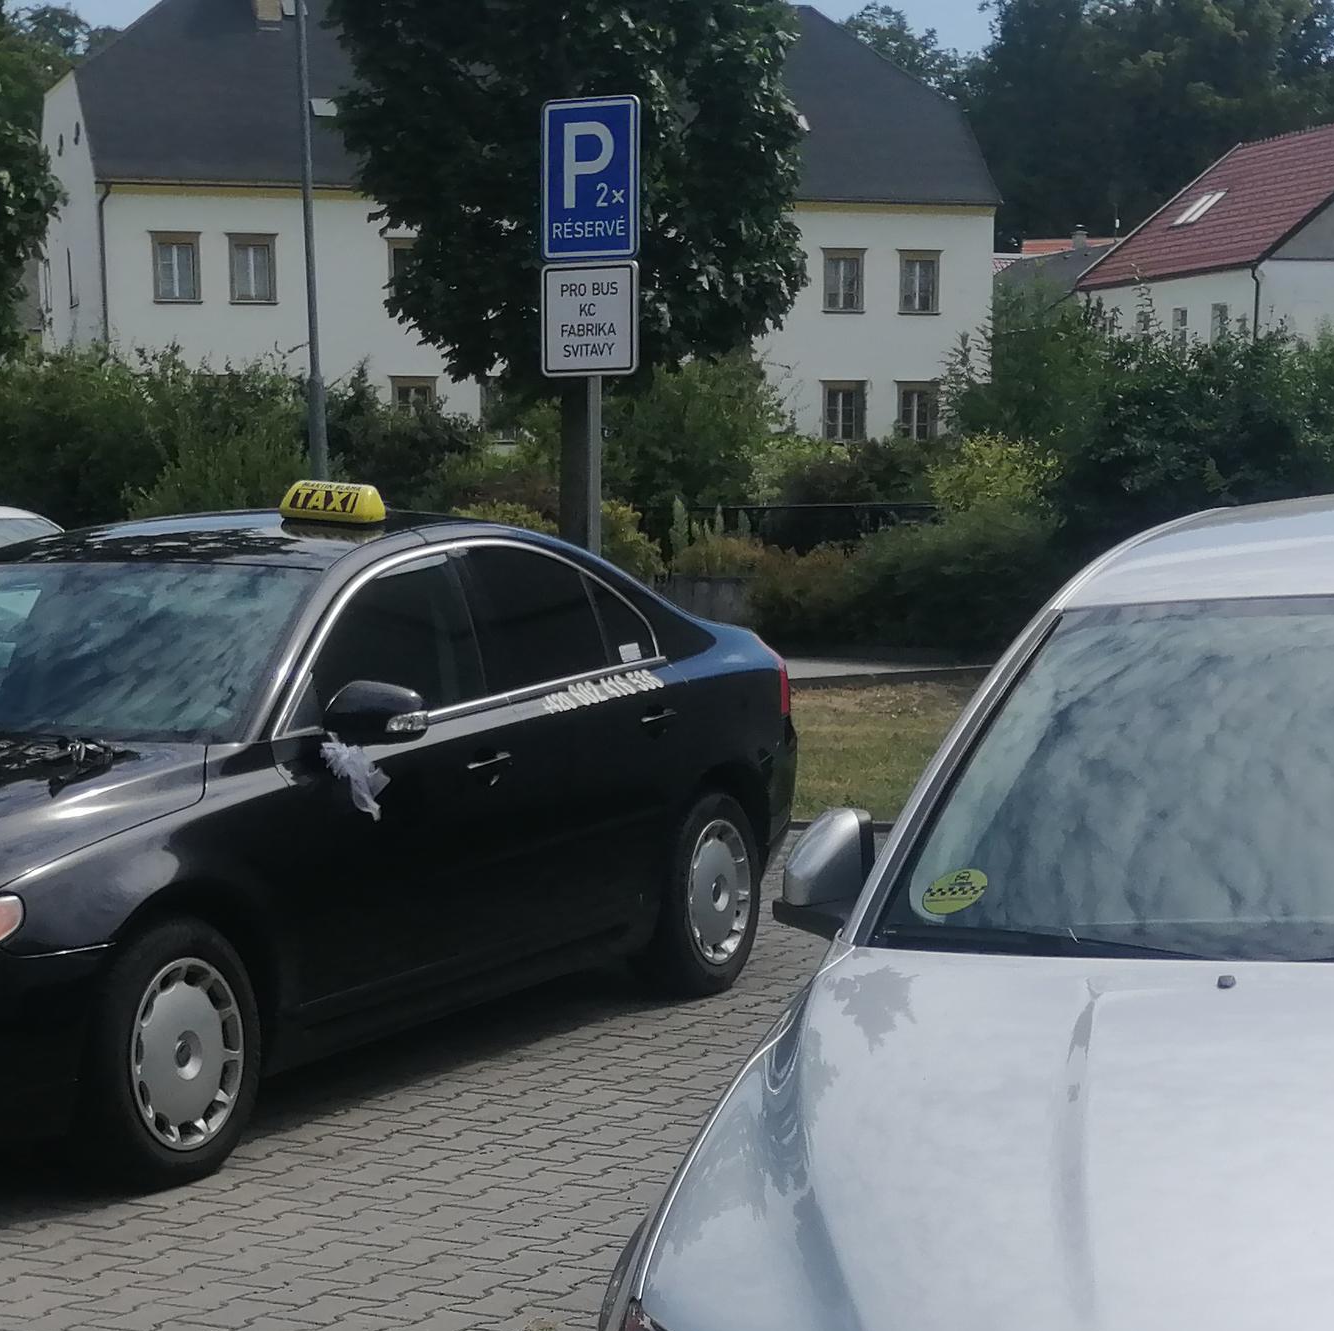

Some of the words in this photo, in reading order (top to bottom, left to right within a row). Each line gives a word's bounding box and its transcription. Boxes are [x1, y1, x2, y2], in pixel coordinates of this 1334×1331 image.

[563, 121, 615, 209] P
[552, 215, 626, 240] RÉSERVÉ
[560, 283, 587, 298] PRO
[592, 281, 618, 296] BUS
[579, 303, 597, 318] KC
[560, 323, 617, 338] FABRIKA
[563, 343, 615, 358] SVITAVY
[297, 489, 357, 512] TAXI
[568, 680, 609, 706] 602
[600, 674, 637, 698] 416
